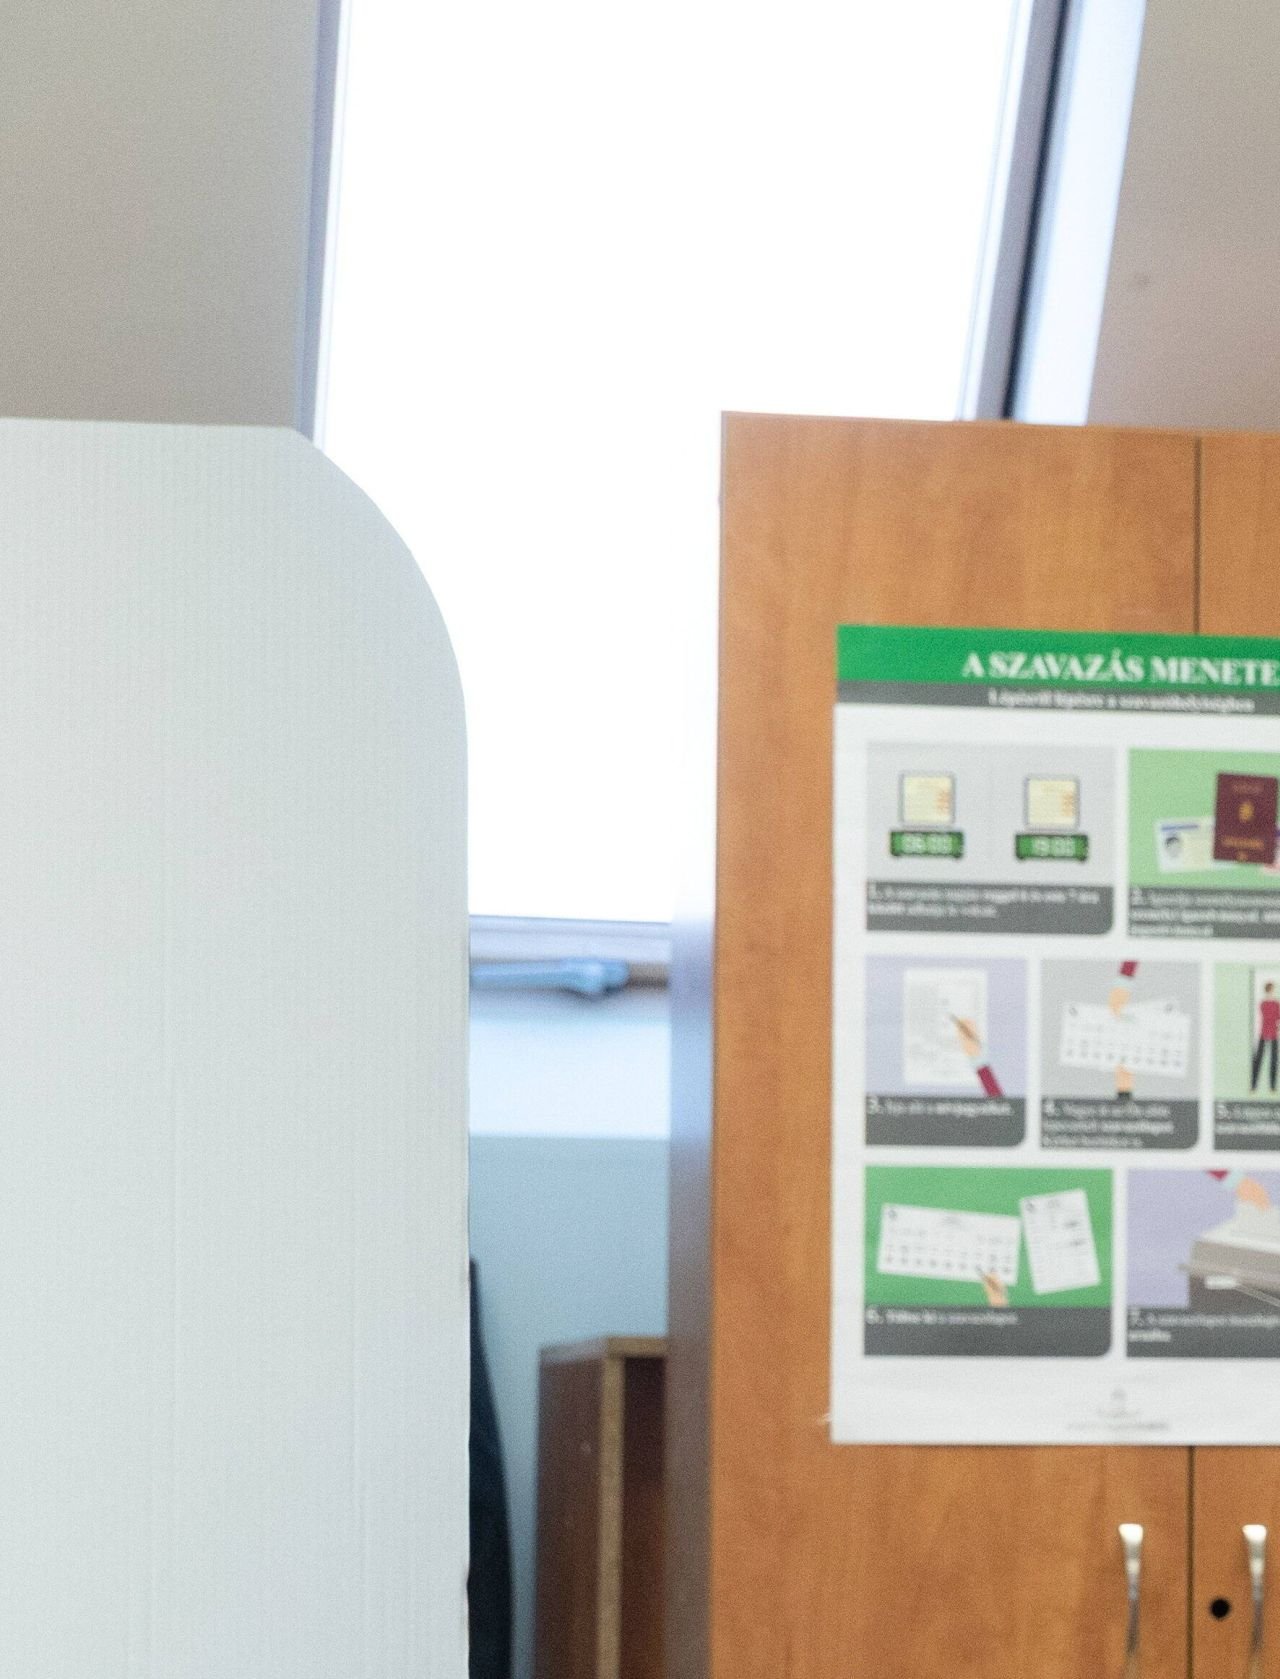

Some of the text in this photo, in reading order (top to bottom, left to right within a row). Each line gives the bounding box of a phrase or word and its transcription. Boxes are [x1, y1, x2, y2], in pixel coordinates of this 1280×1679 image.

[962, 649, 1280, 686] A SZAVAZÁS MENETE
